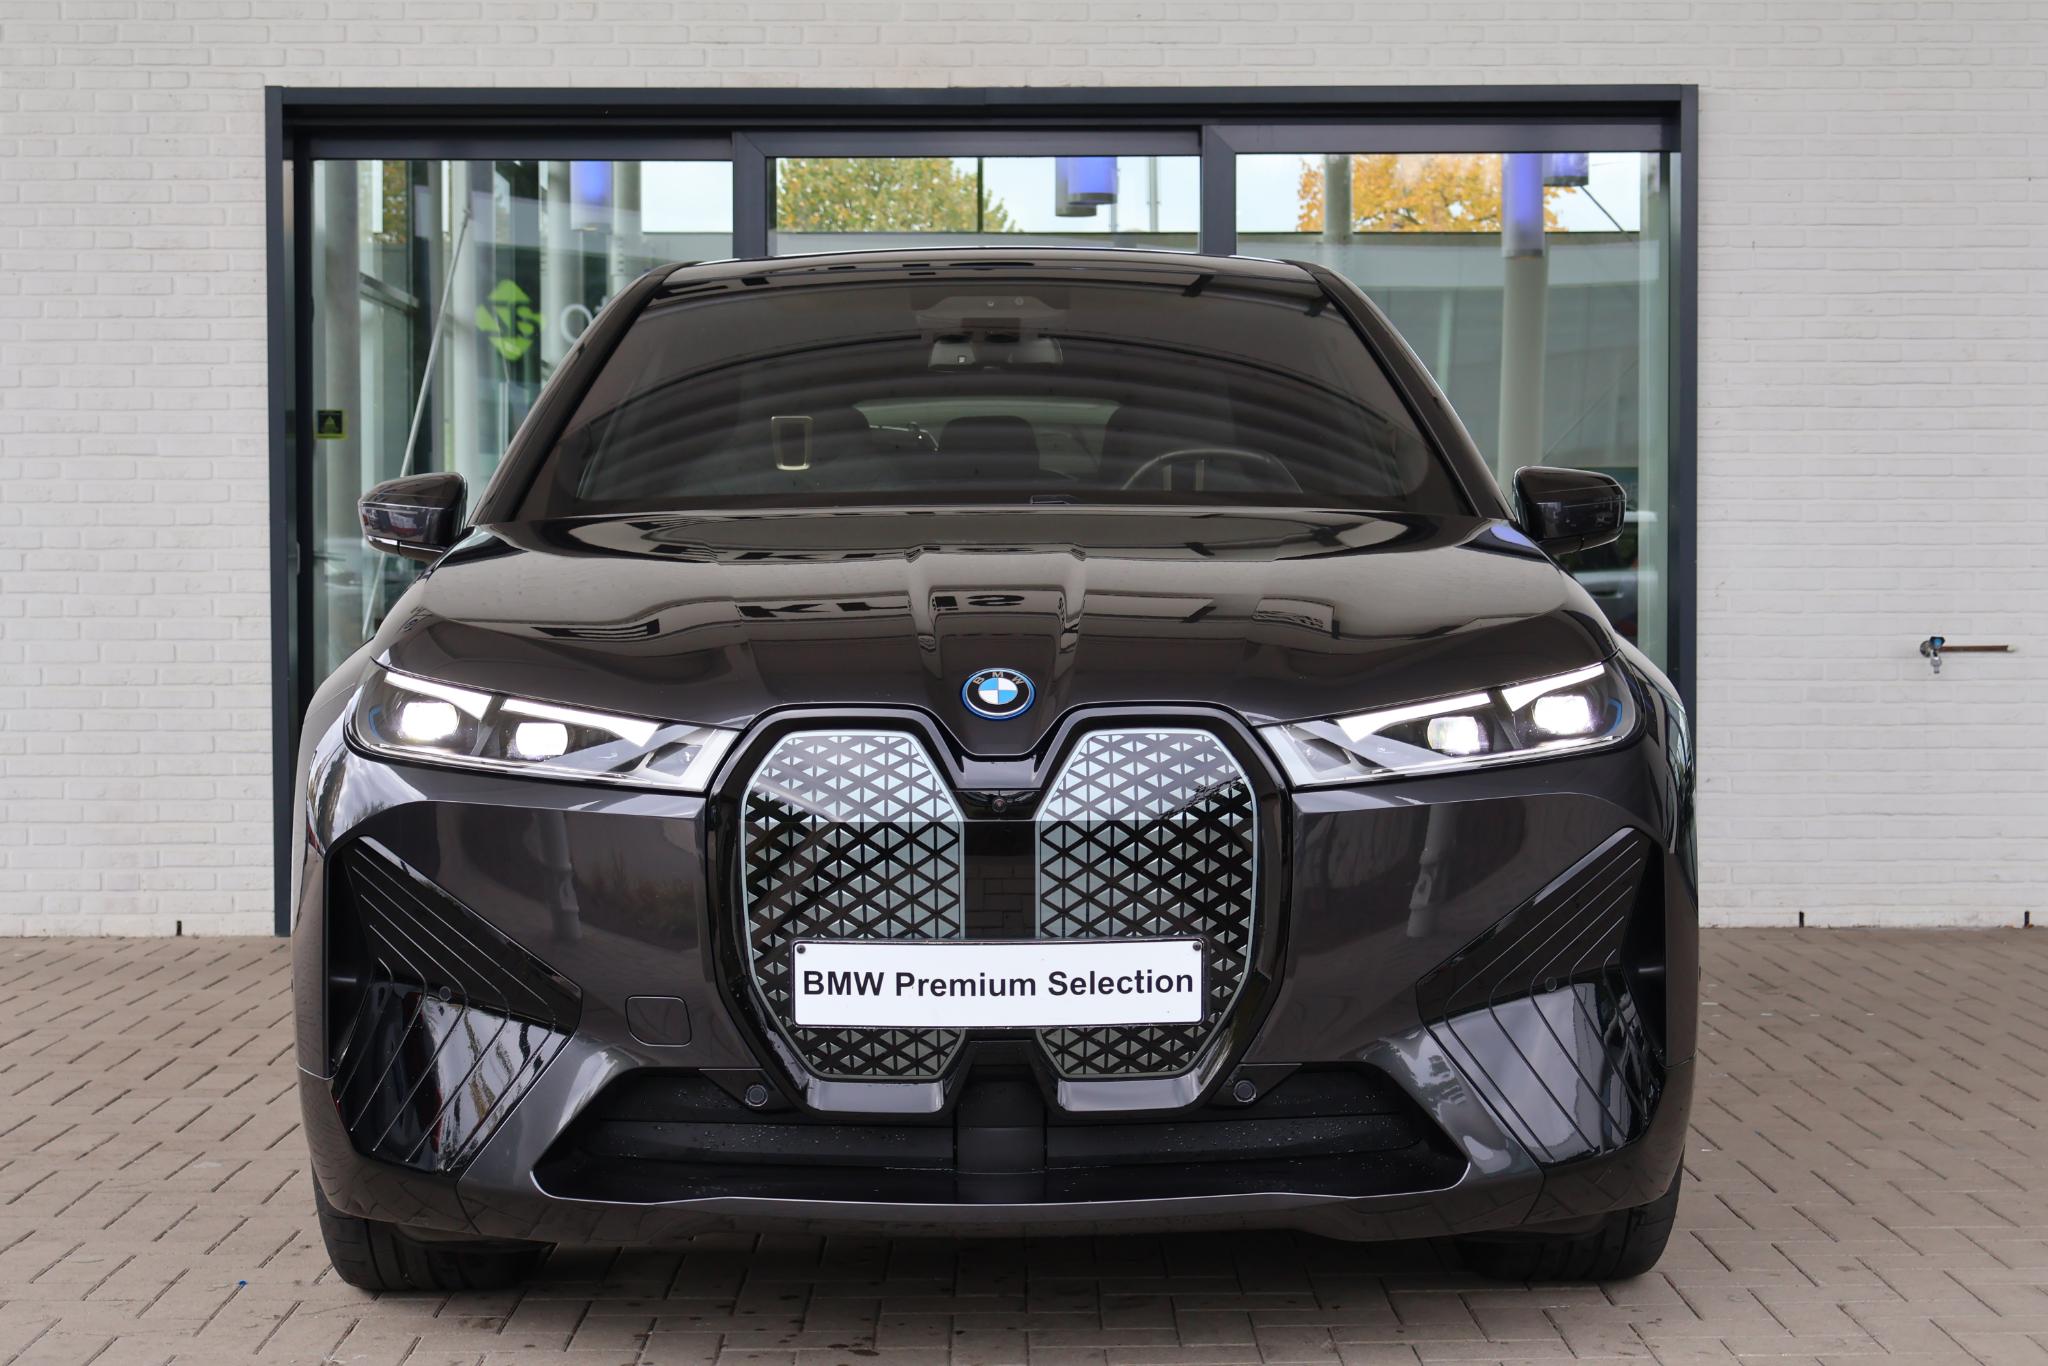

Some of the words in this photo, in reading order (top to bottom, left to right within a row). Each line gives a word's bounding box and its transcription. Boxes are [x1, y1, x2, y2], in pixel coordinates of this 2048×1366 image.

[972, 671, 1024, 685] BMW
[803, 970, 884, 996] BMW
[895, 972, 1036, 997] Premium
[1048, 969, 1193, 996] Selection
